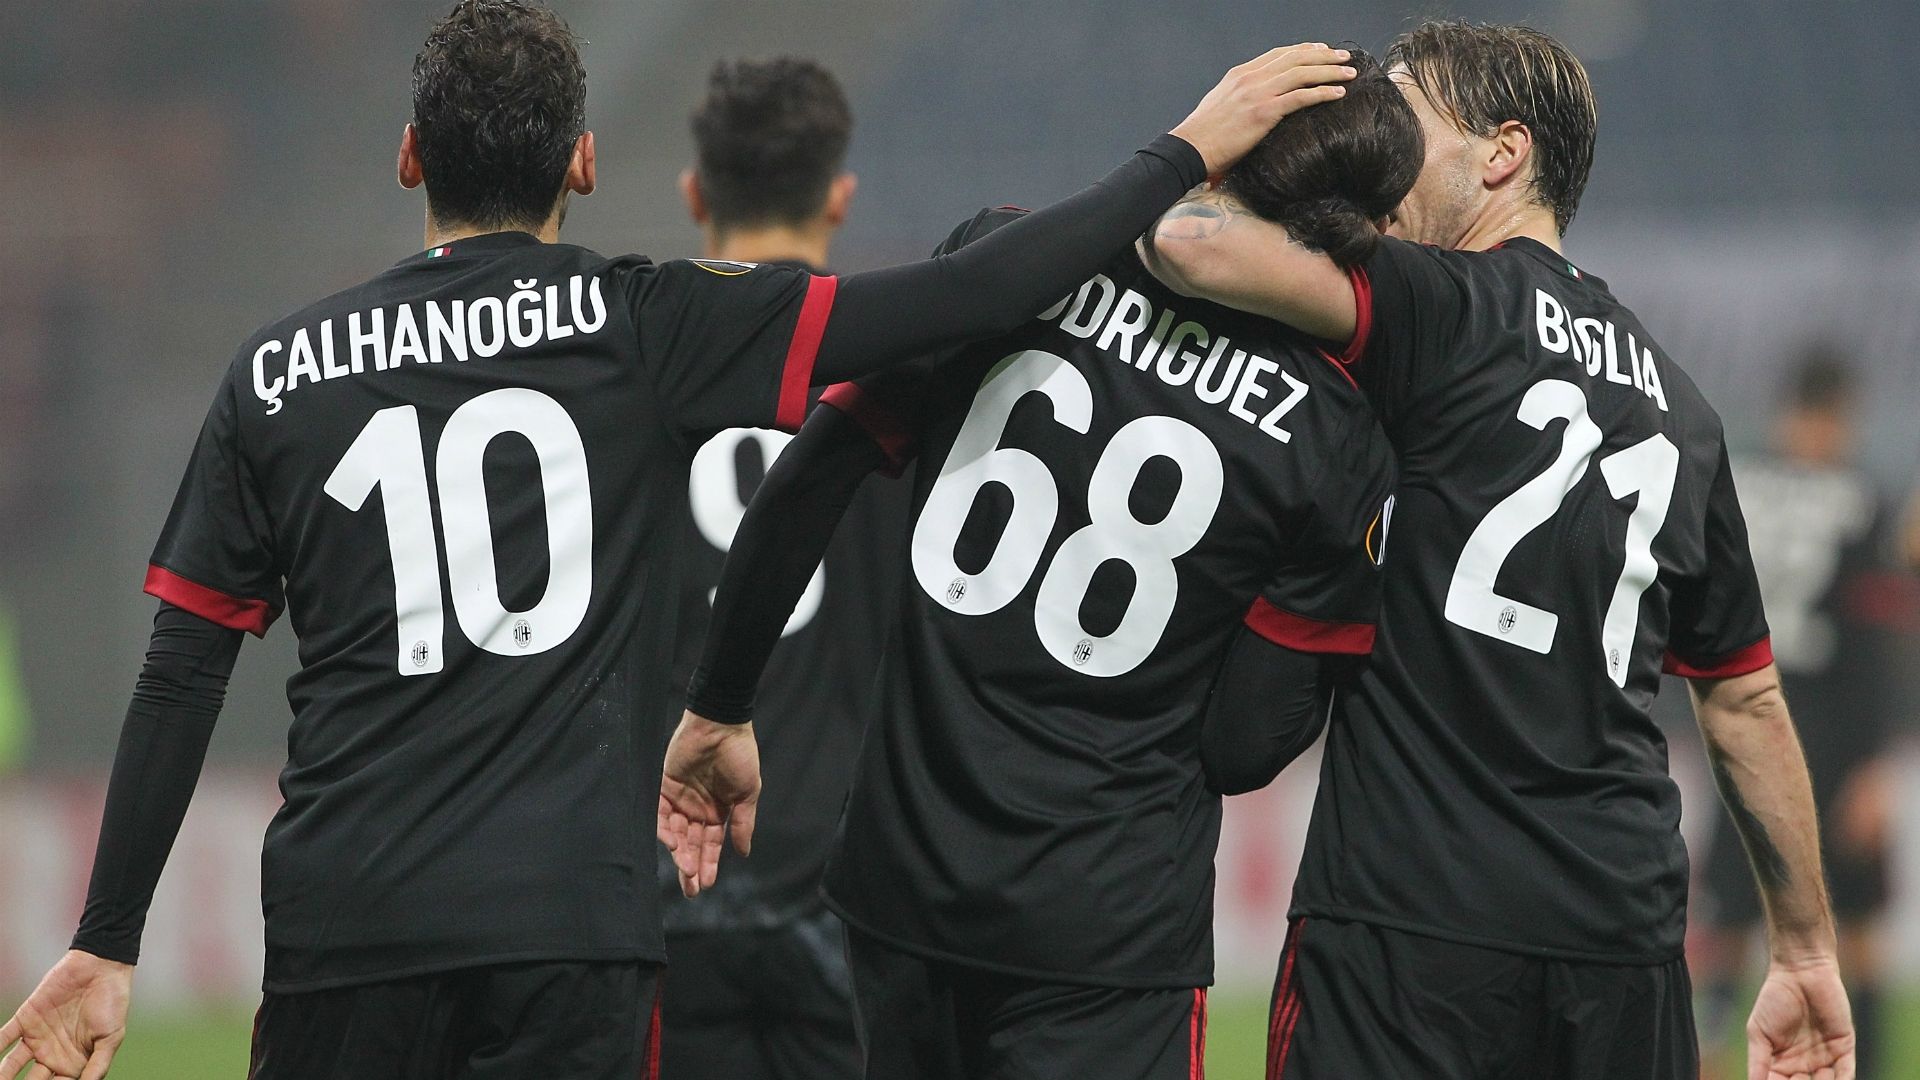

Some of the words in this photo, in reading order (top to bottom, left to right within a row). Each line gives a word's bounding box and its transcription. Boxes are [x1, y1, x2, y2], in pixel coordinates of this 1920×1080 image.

[252, 275, 607, 416] ÇALHANOĞLU
[1036, 273, 1310, 444] DRIGUEZ
[1535, 288, 1669, 412] BIGLIA
[323, 387, 593, 677] 10
[910, 349, 1224, 678] 68
[1444, 378, 1680, 689] 21
